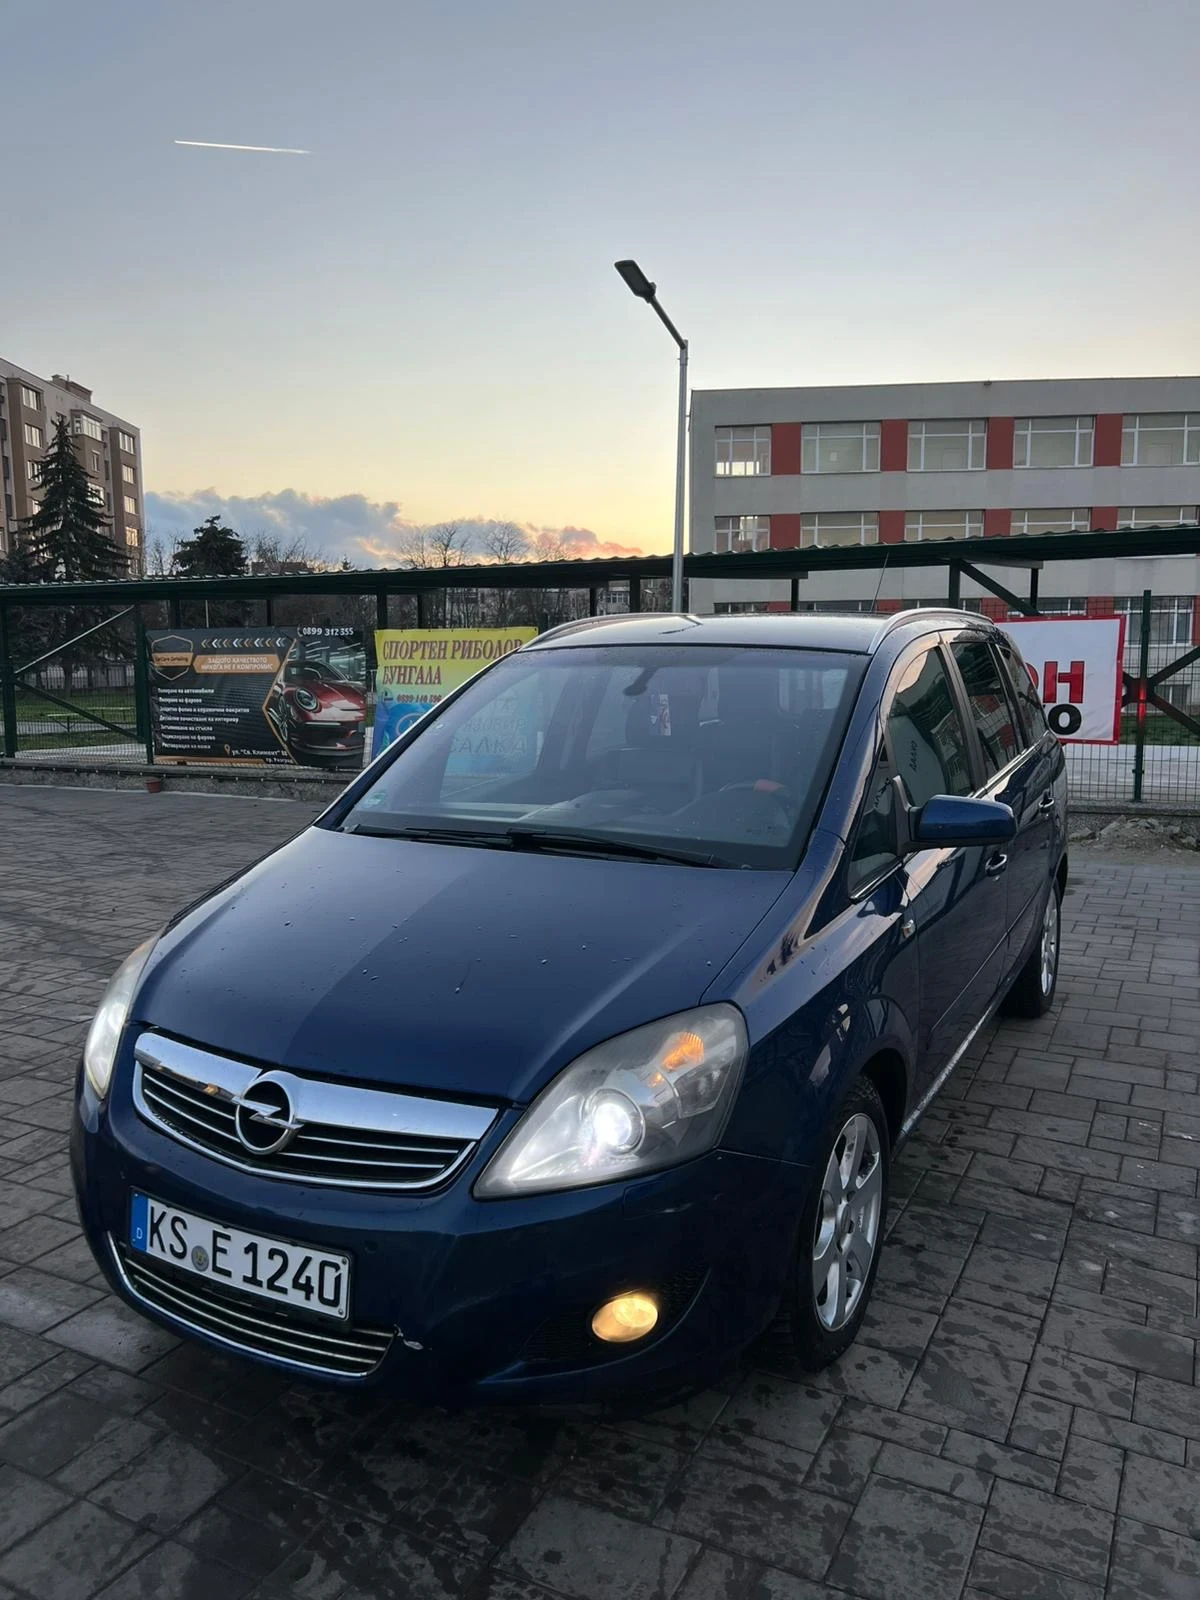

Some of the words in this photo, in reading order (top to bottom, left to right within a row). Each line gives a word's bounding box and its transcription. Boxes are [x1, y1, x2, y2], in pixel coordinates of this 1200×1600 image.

[302, 627, 323, 636] 0899
[383, 640, 448, 661] СПОРТЕН
[383, 665, 442, 685] БУНГАЛА
[1024, 661, 1085, 704] Н
[1042, 704, 1082, 736] О
[136, 1226, 143, 1240] D
[150, 1205, 188, 1260] KS
